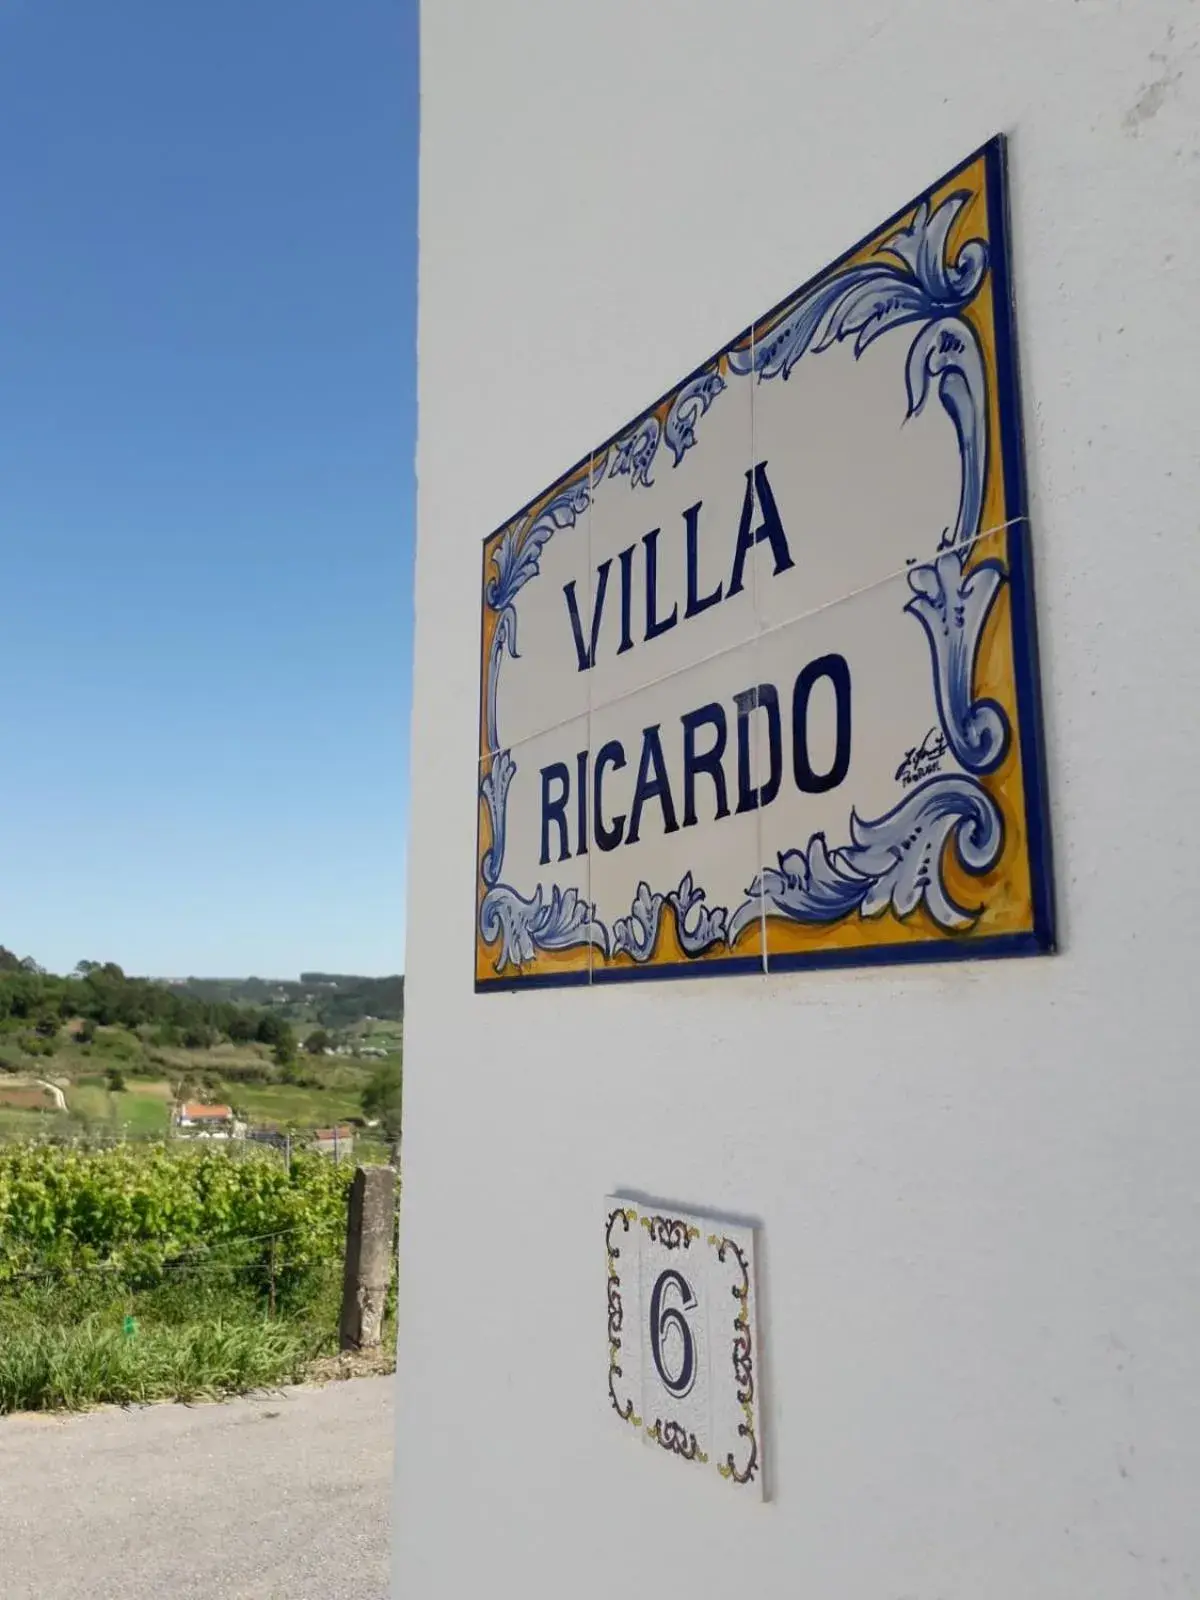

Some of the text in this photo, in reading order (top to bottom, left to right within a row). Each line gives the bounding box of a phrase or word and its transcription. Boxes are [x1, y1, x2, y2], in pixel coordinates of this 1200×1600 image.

[562, 460, 795, 672] VILLA
[539, 653, 851, 865] RICARDO
[650, 1269, 698, 1399] 6
